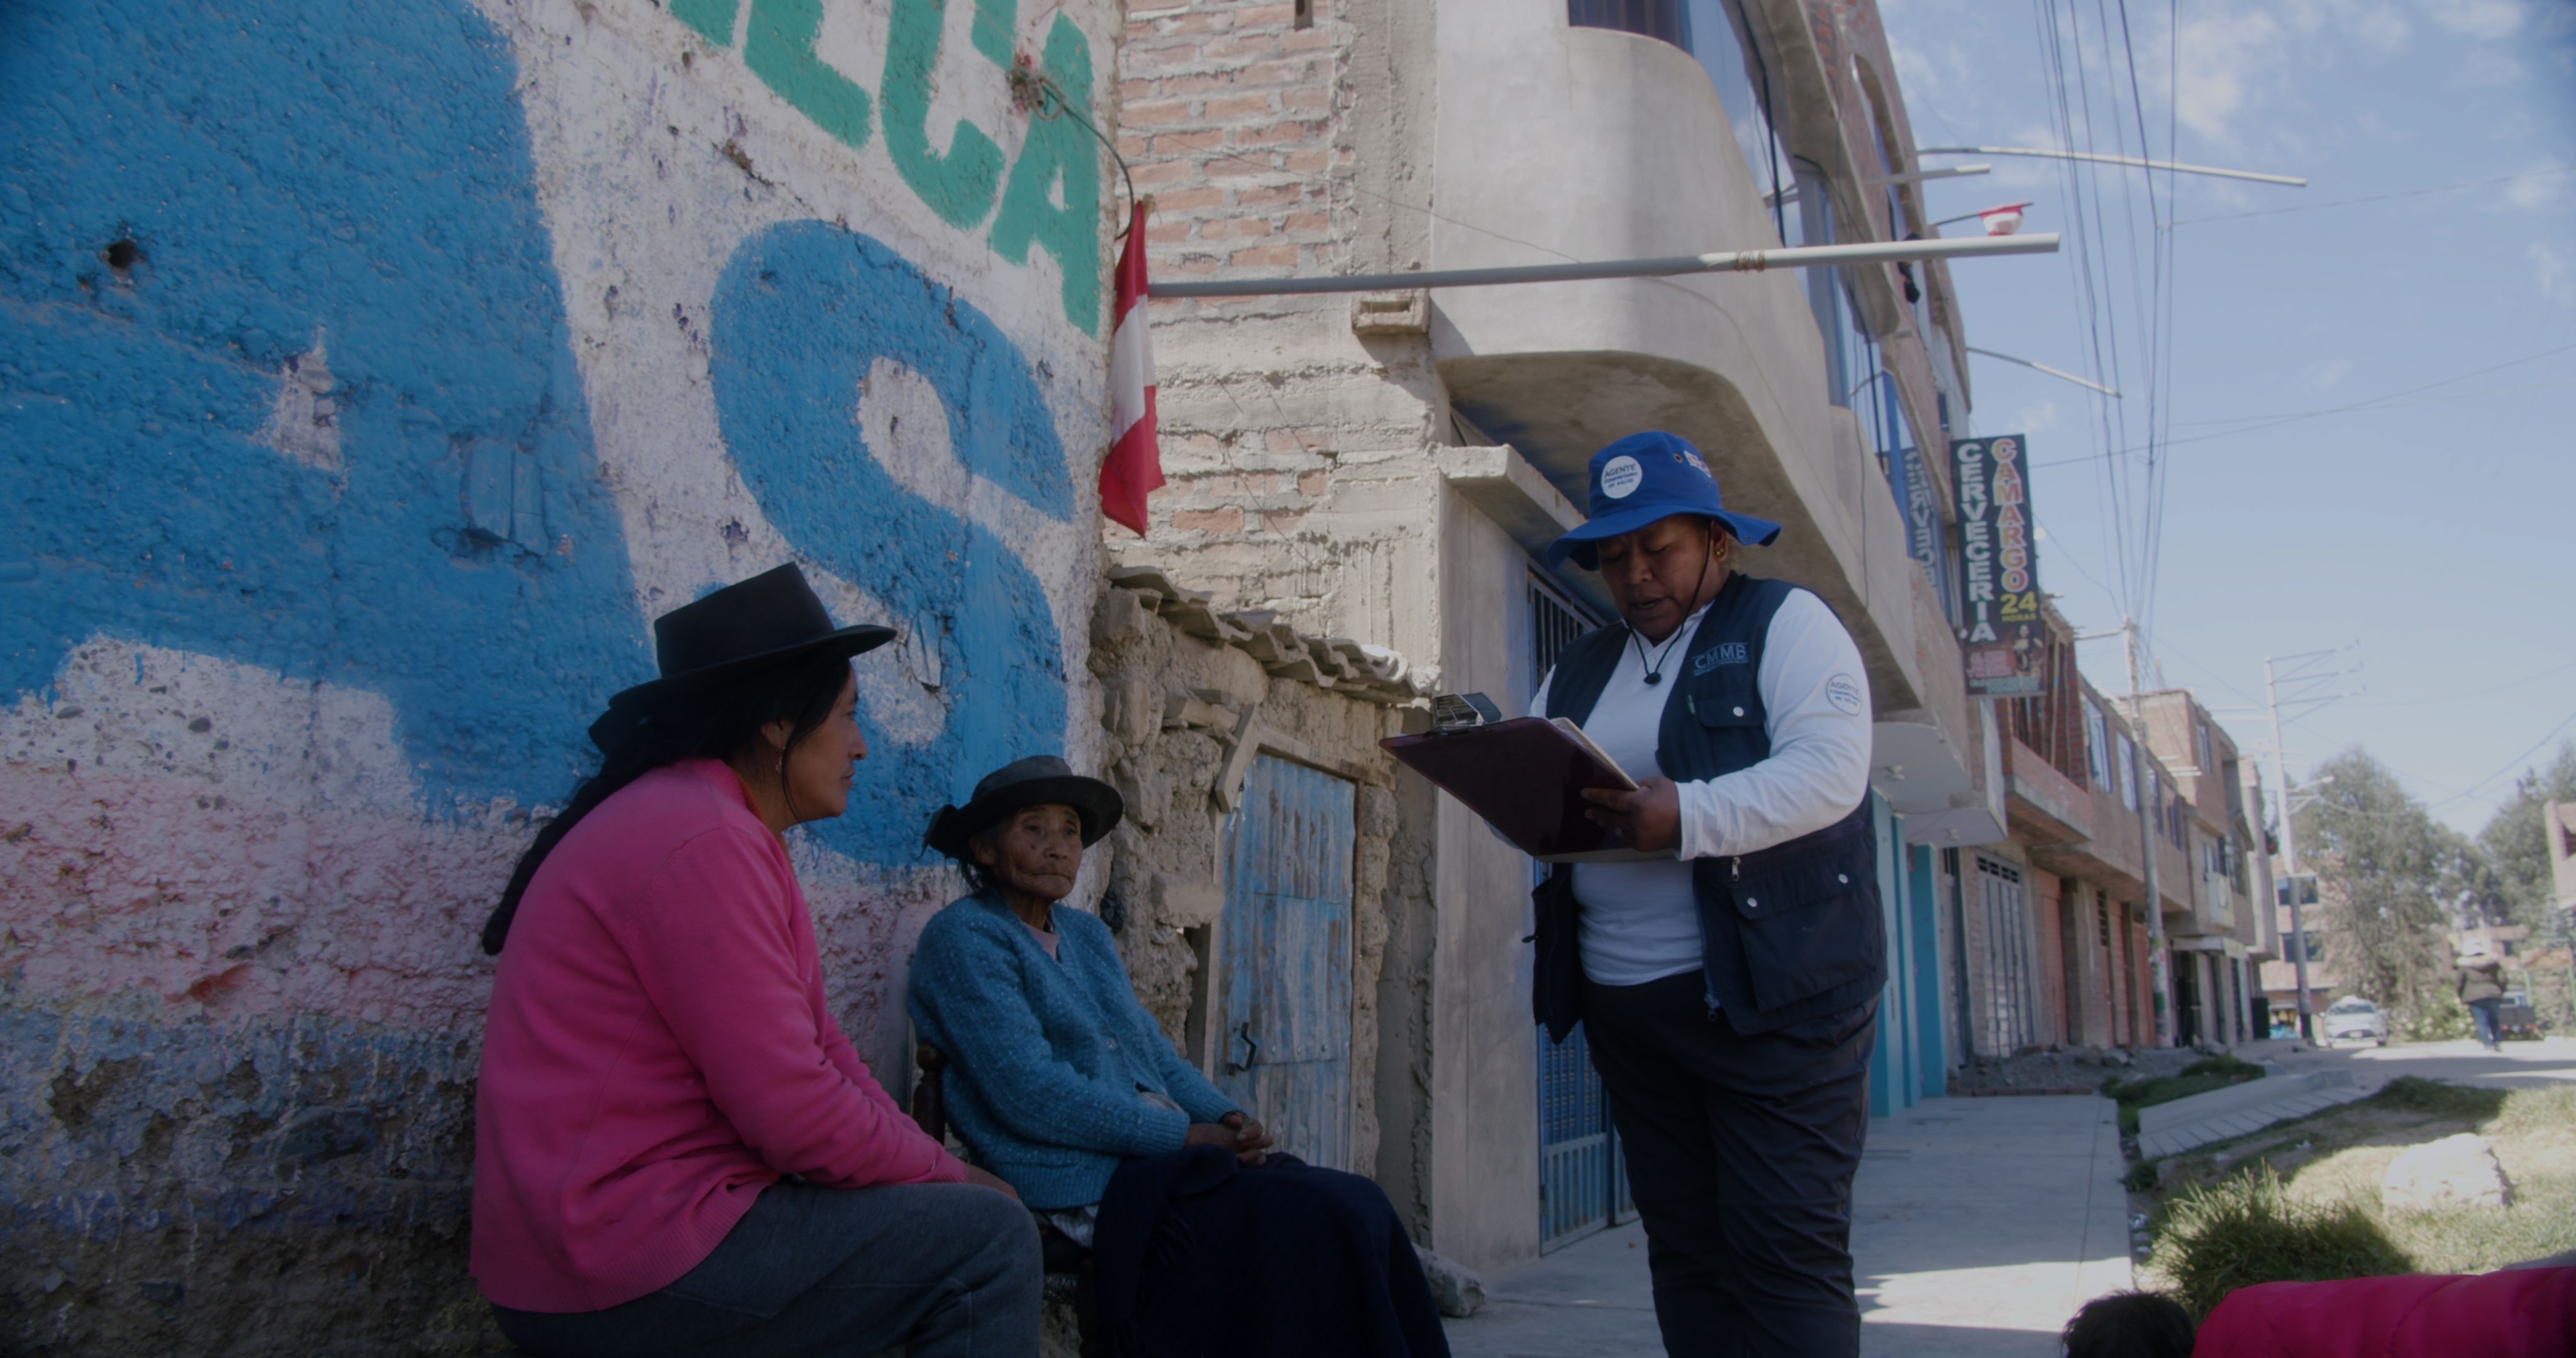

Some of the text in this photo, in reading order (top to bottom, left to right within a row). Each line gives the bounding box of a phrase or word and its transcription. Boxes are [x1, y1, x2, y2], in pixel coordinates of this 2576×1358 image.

[1604, 463, 1636, 478] AGENTE
[1990, 438, 2029, 592] CAMARGO
[1957, 443, 1997, 642] CERVECERIA
[2000, 591, 2038, 614] 24
[1695, 644, 1747, 669] CMMB
